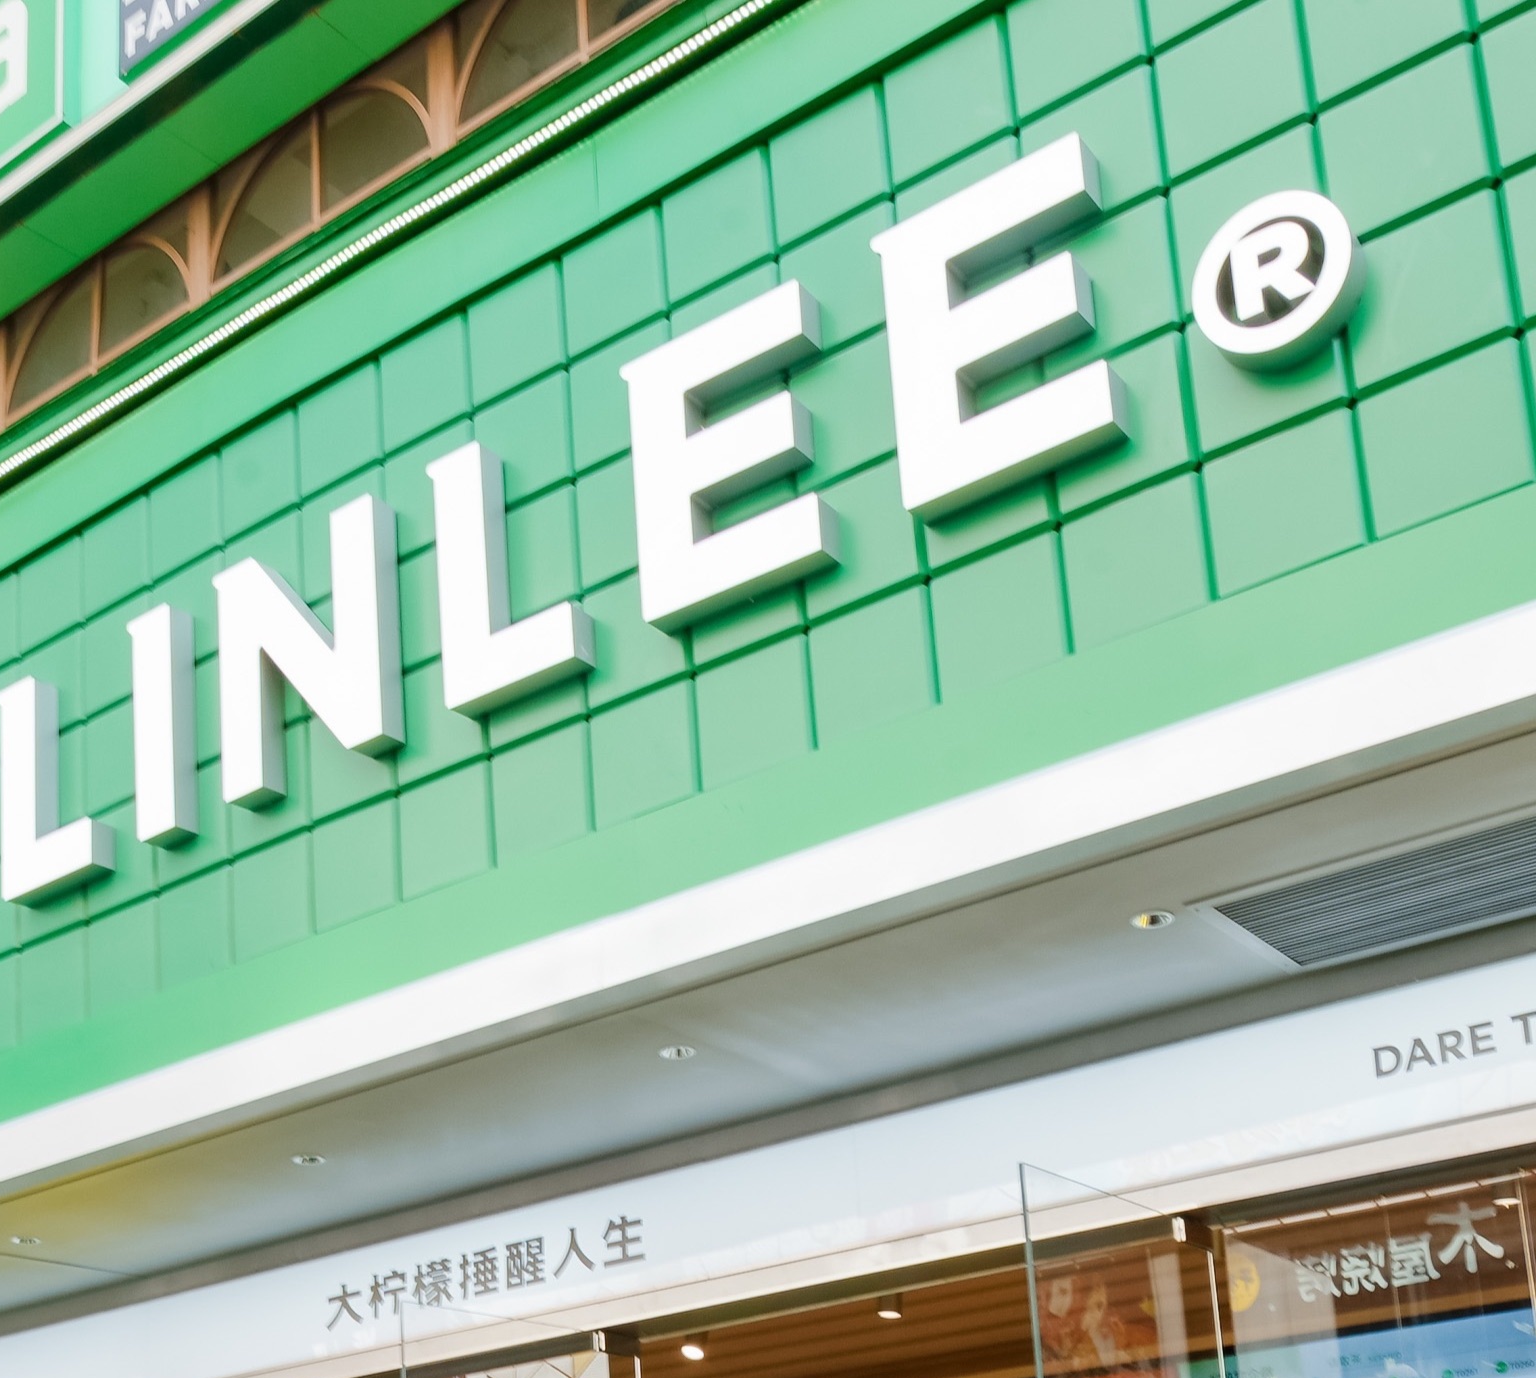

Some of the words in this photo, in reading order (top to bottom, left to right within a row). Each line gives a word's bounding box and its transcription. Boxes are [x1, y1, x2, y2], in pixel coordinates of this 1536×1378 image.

[1372, 1021, 1496, 1079] DARE
[325, 1213, 647, 1333] 大柠檬捶醒人生
